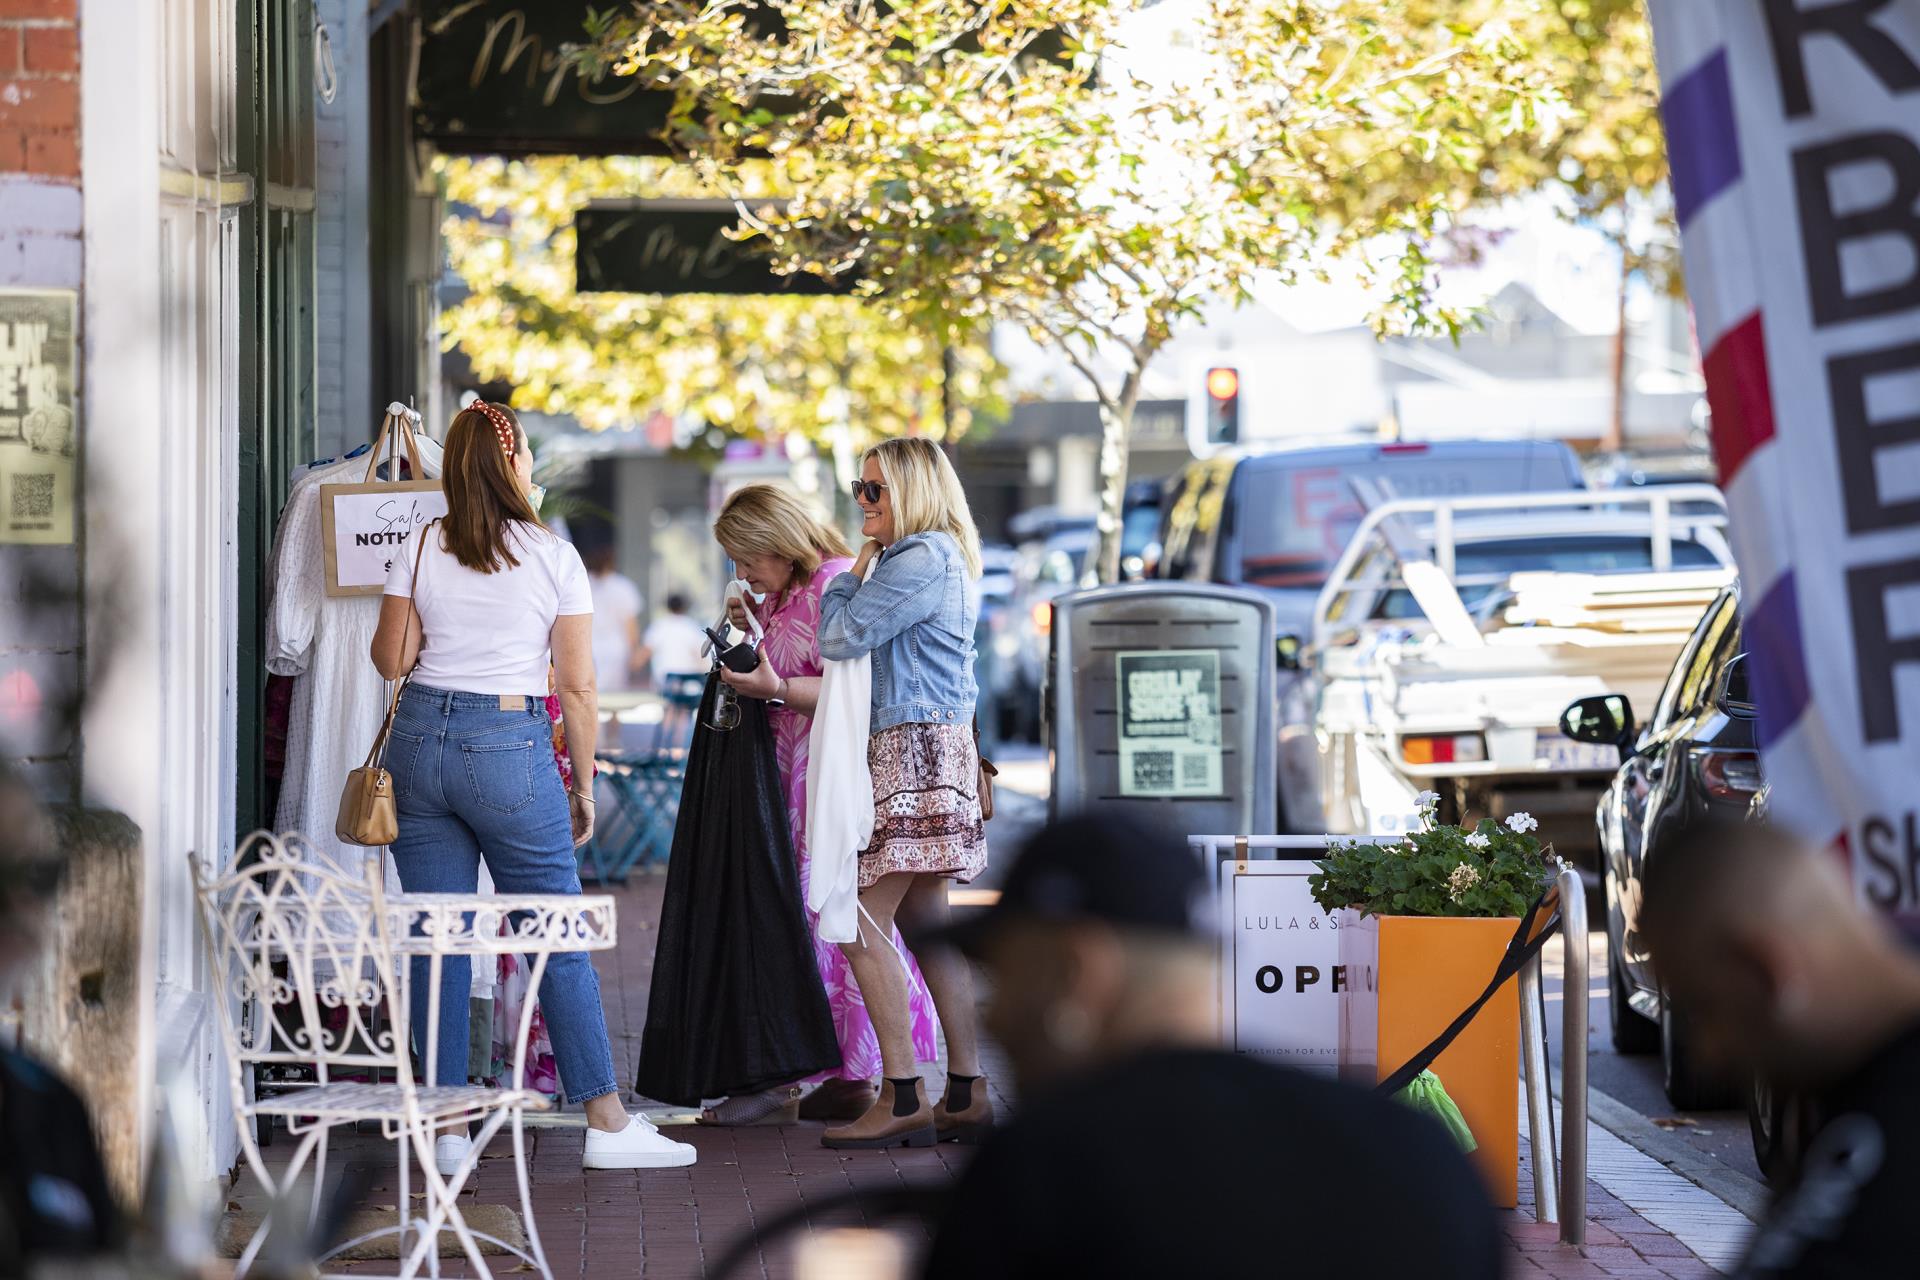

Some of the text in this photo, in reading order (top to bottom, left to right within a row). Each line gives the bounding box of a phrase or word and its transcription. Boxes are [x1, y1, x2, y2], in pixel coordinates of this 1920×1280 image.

[376, 499, 425, 534] Sale
[356, 531, 410, 546] NOTH
[1245, 916, 1299, 930] LULA
[1308, 916, 1319, 930] &
